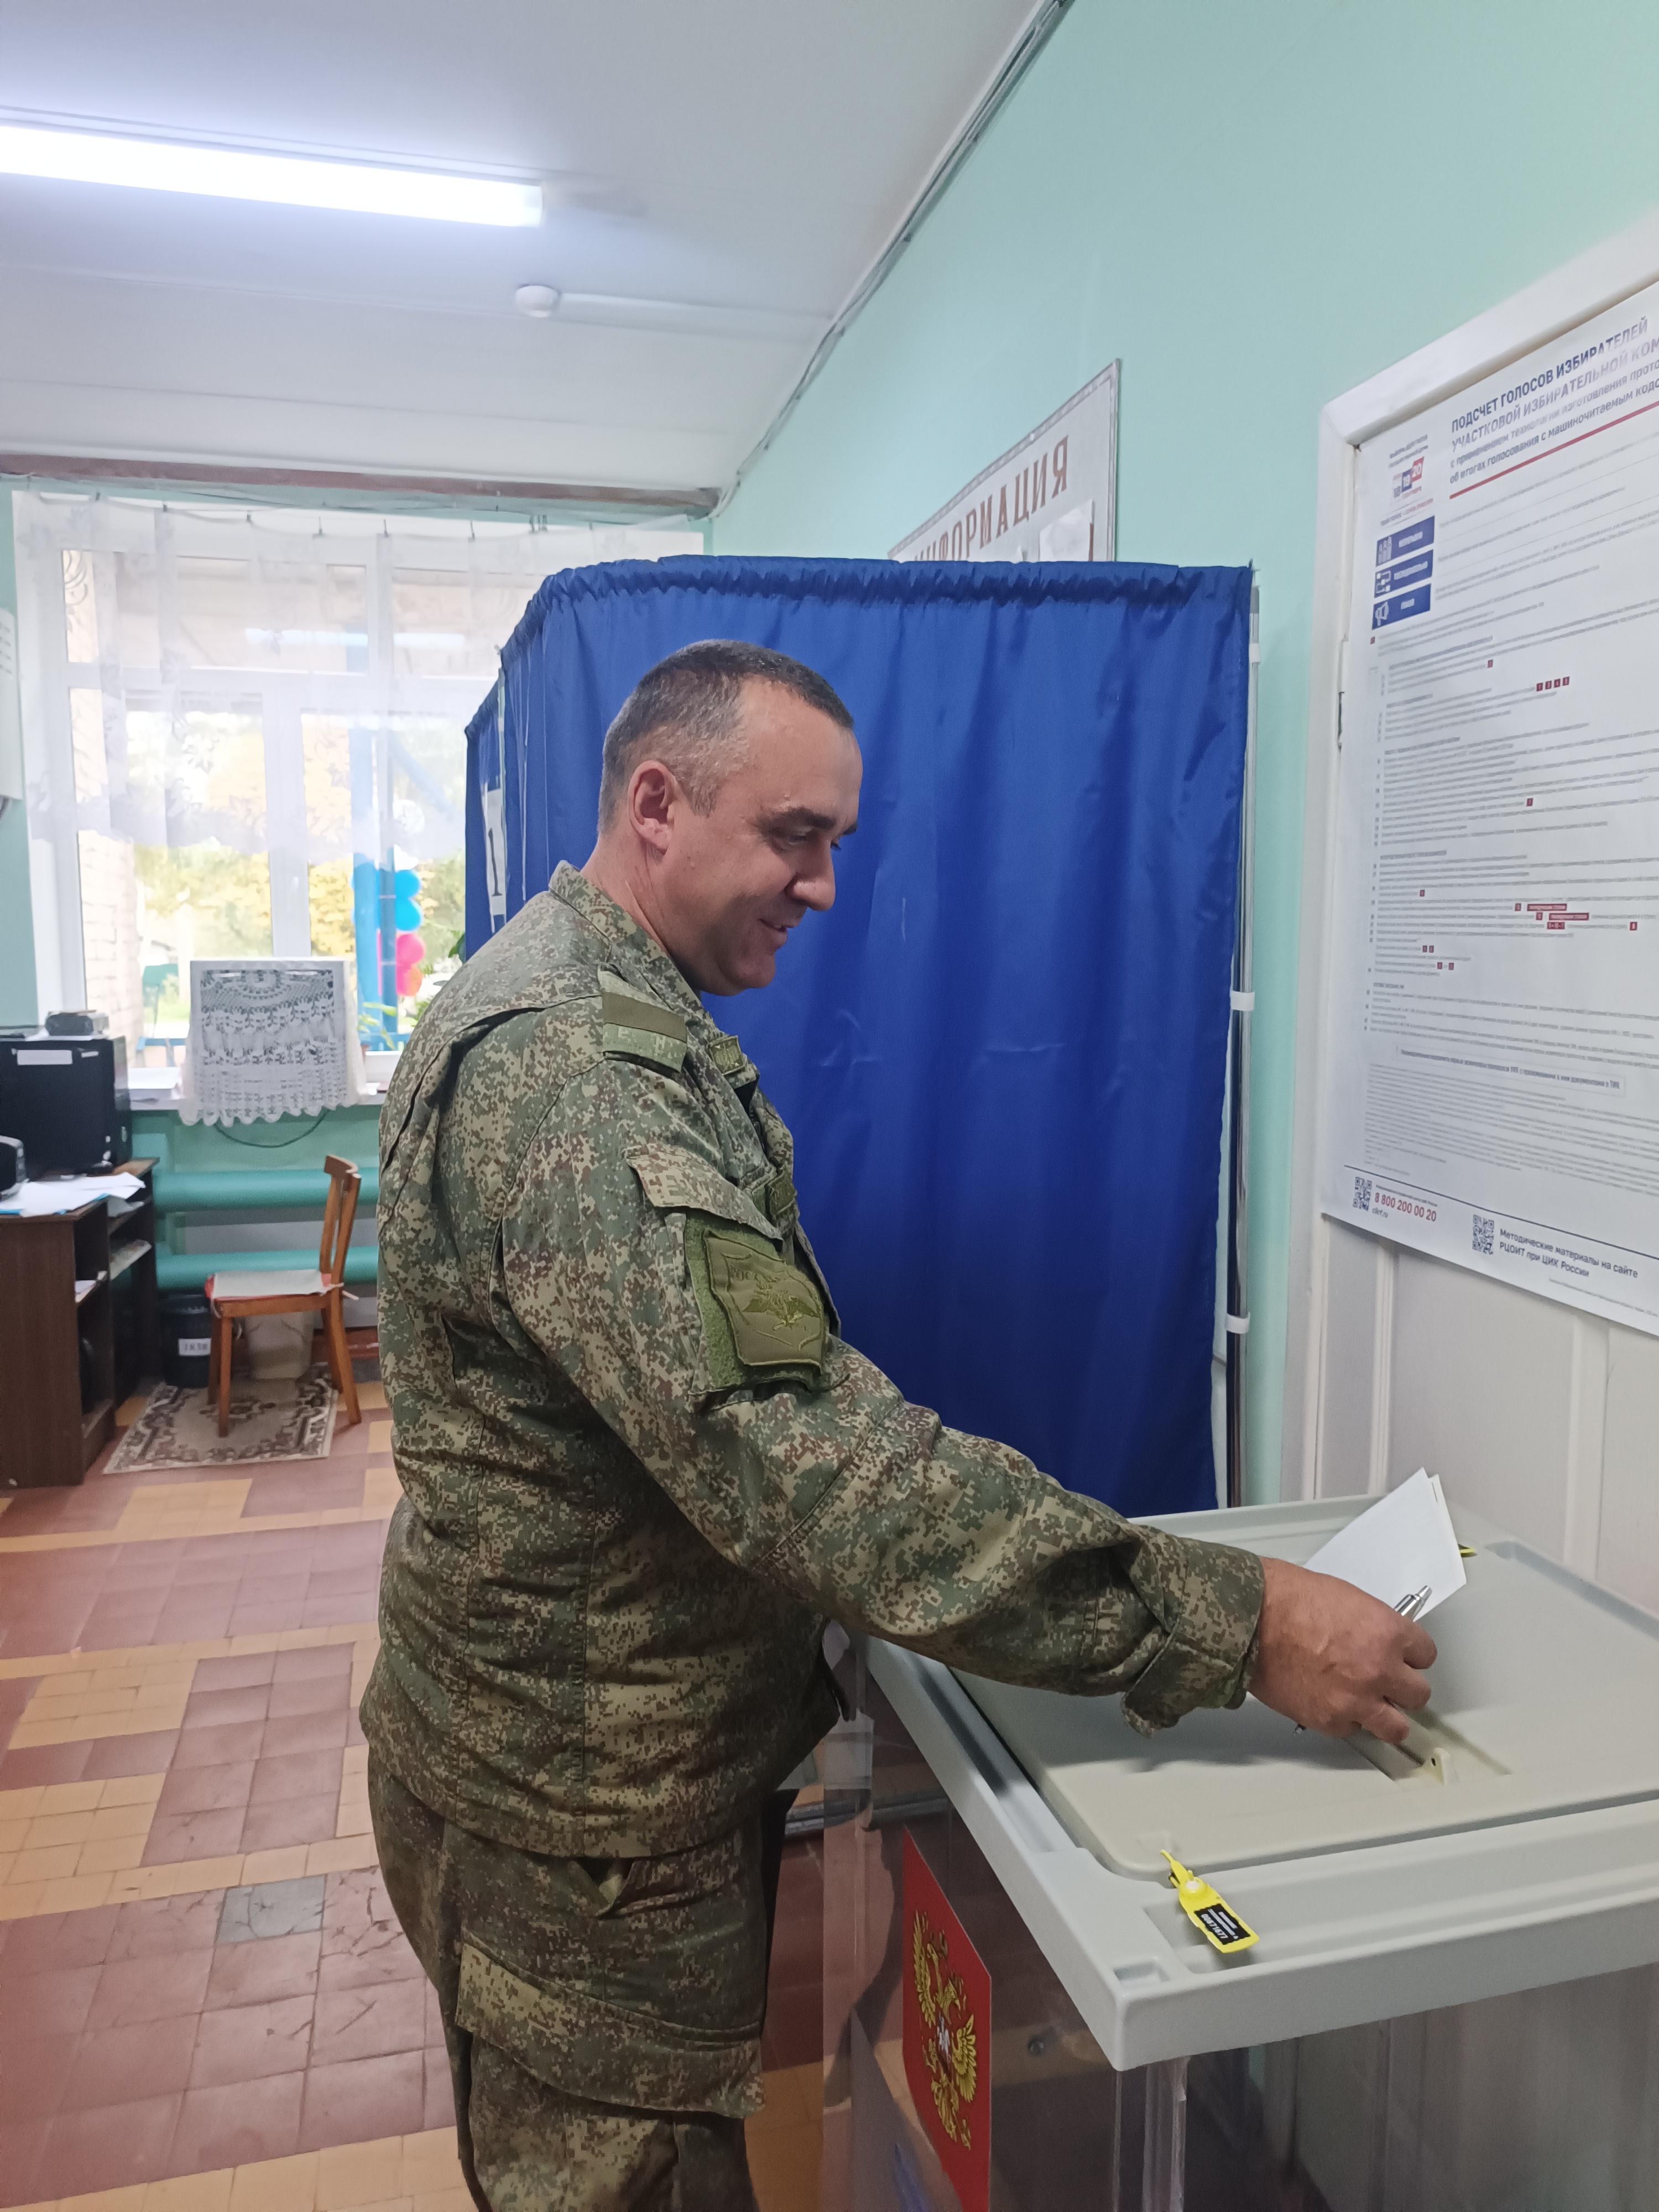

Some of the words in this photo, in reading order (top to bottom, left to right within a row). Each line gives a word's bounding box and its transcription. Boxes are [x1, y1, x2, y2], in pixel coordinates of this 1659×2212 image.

[1452, 397, 1498, 433] ПОДСЧЕТ
[1501, 369, 1553, 408] ГОЛОСОВ
[1556, 315, 1648, 379] ИЗБИРАТЕЛЕЙ
[1452, 404, 1521, 452] УЧАСТКОВОЙ
[1524, 349, 1628, 417] ИЗБИРАТЕЛЬНОЙ
[1450, 471, 1459, 484] об
[1460, 461, 1485, 478] итогах
[1487, 435, 1539, 467] голосования
[1541, 432, 1546, 441] с
[1548, 391, 1633, 438] машиночитаемым
[1451, 460, 1455, 468] с
[1562, 375, 1627, 414] изготовления
[914, 435, 1068, 561] ФОРМАЦИЯ
[1412, 463, 1421, 478] 20
[1375, 1192, 1379, 1203] 8
[1381, 1194, 1395, 1208] 800
[1397, 1199, 1412, 1213] 200
[1414, 1205, 1425, 1217] 00
[1426, 1209, 1436, 1222] 20
[1500, 1228, 1553, 1252] Методические
[1555, 1247, 1599, 1266] материалы
[1601, 1260, 1611, 1270] на
[1613, 1265, 1638, 1278] сайте
[1500, 1241, 1525, 1256] РЦОИТ
[1526, 1251, 1540, 1261] при
[1542, 1255, 1559, 1267] ЦИК
[1561, 1261, 1589, 1277] России
